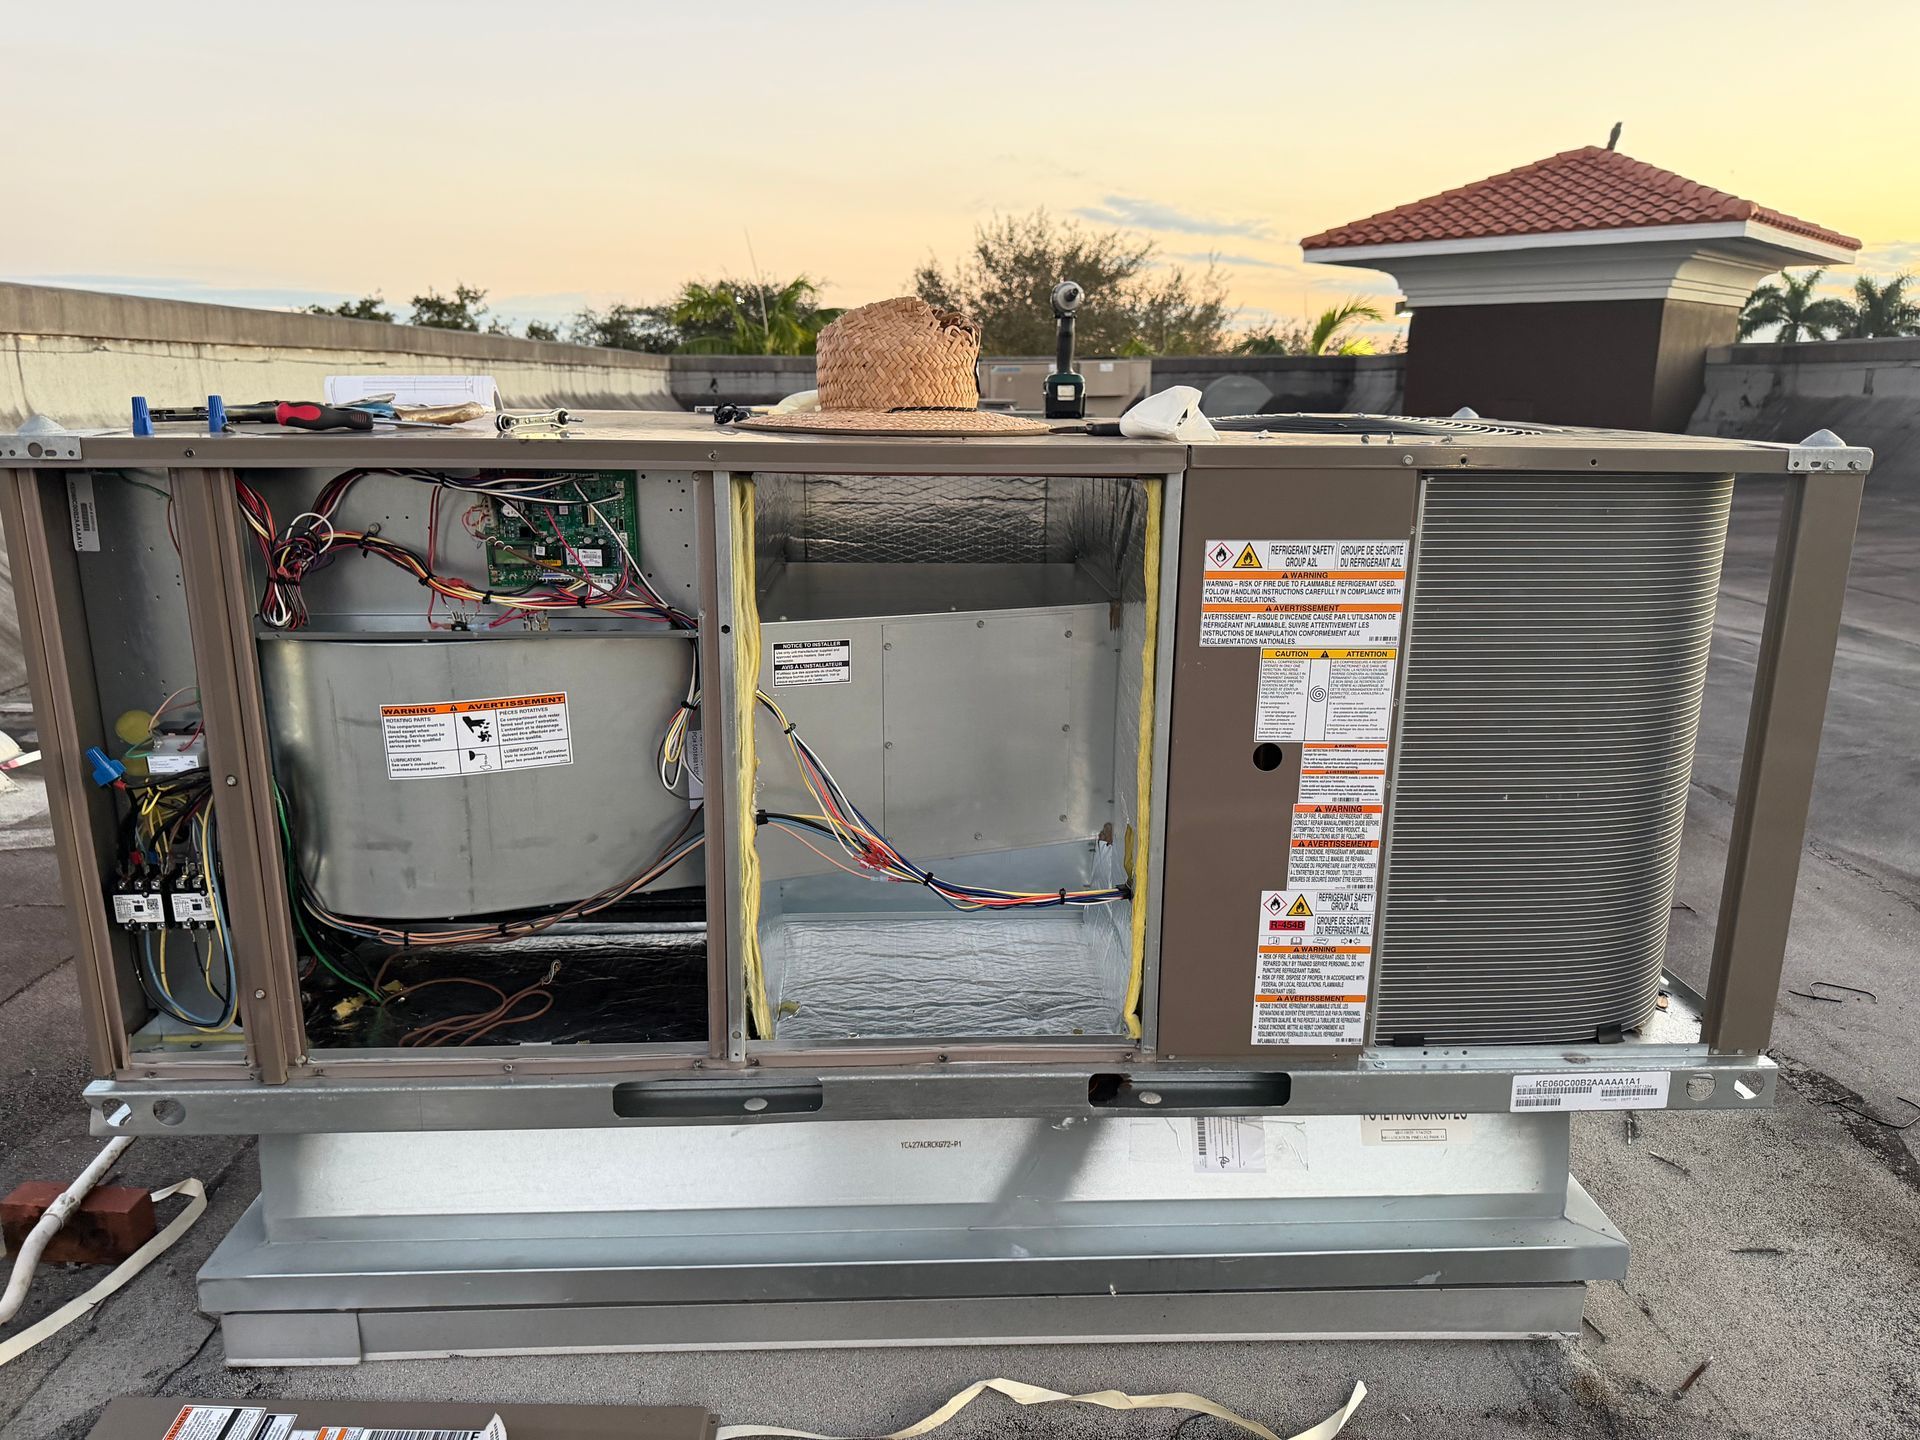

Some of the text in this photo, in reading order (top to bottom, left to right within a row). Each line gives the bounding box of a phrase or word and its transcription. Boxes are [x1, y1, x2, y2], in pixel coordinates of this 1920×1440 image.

[1270, 544, 1334, 554] REFRIGERANT SAFETY
[1340, 545, 1364, 554] GROUPE
[1365, 545, 1374, 554] DE
[1285, 557, 1318, 567] GROUP A2L
[1340, 558, 1348, 567] DU
[1390, 558, 1402, 567] A2L
[468, 696, 564, 710] AVERTISSEMENT
[1536, 1078, 1640, 1087] KE060C00B2AAAAA1A1
